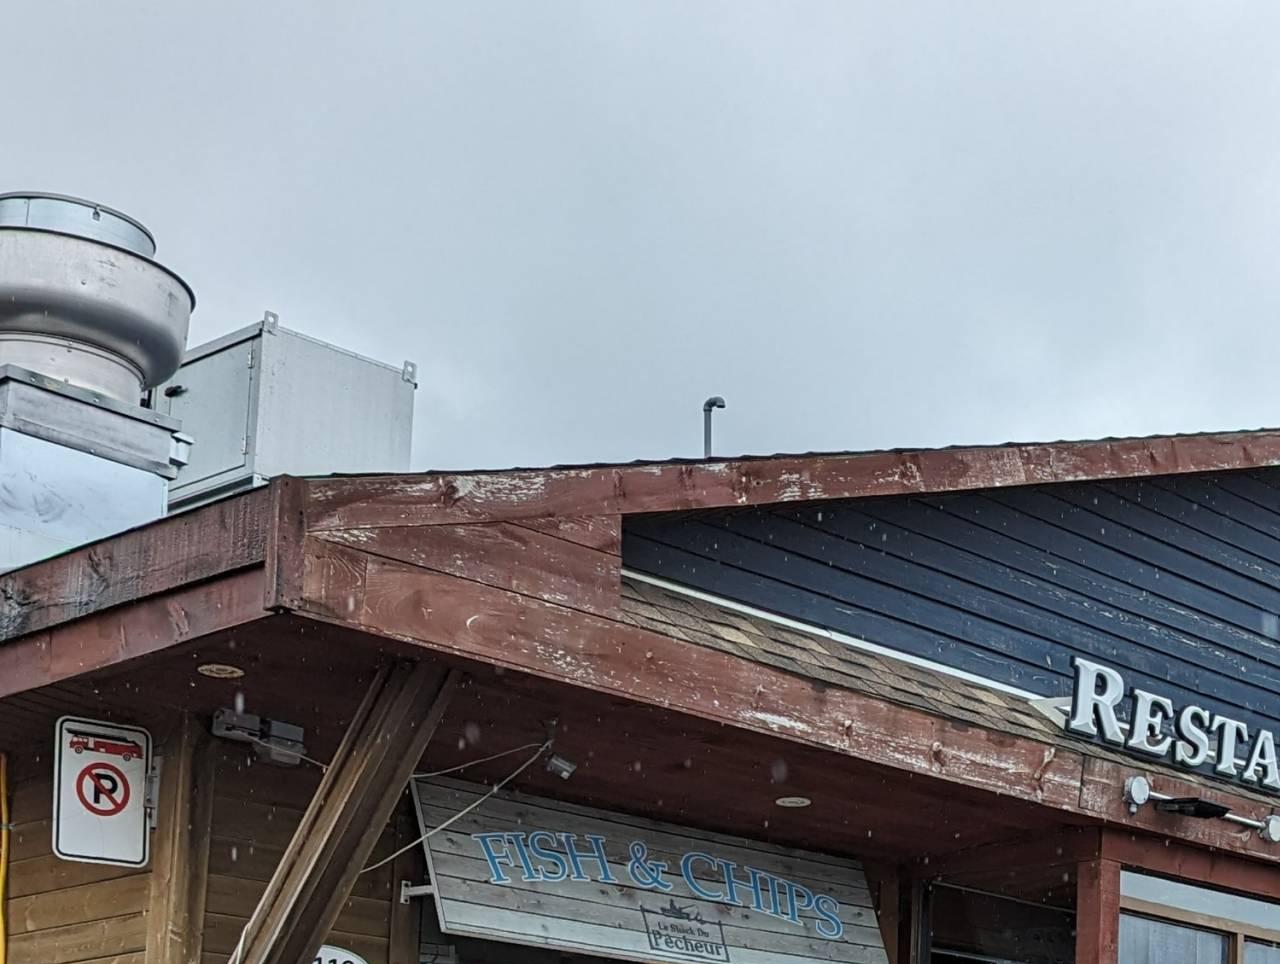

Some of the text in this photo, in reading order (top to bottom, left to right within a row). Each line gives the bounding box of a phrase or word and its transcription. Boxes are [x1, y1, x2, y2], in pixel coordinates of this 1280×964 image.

[471, 831, 847, 938] FISH & CHIPS
[652, 929, 723, 956] Pêcheur
